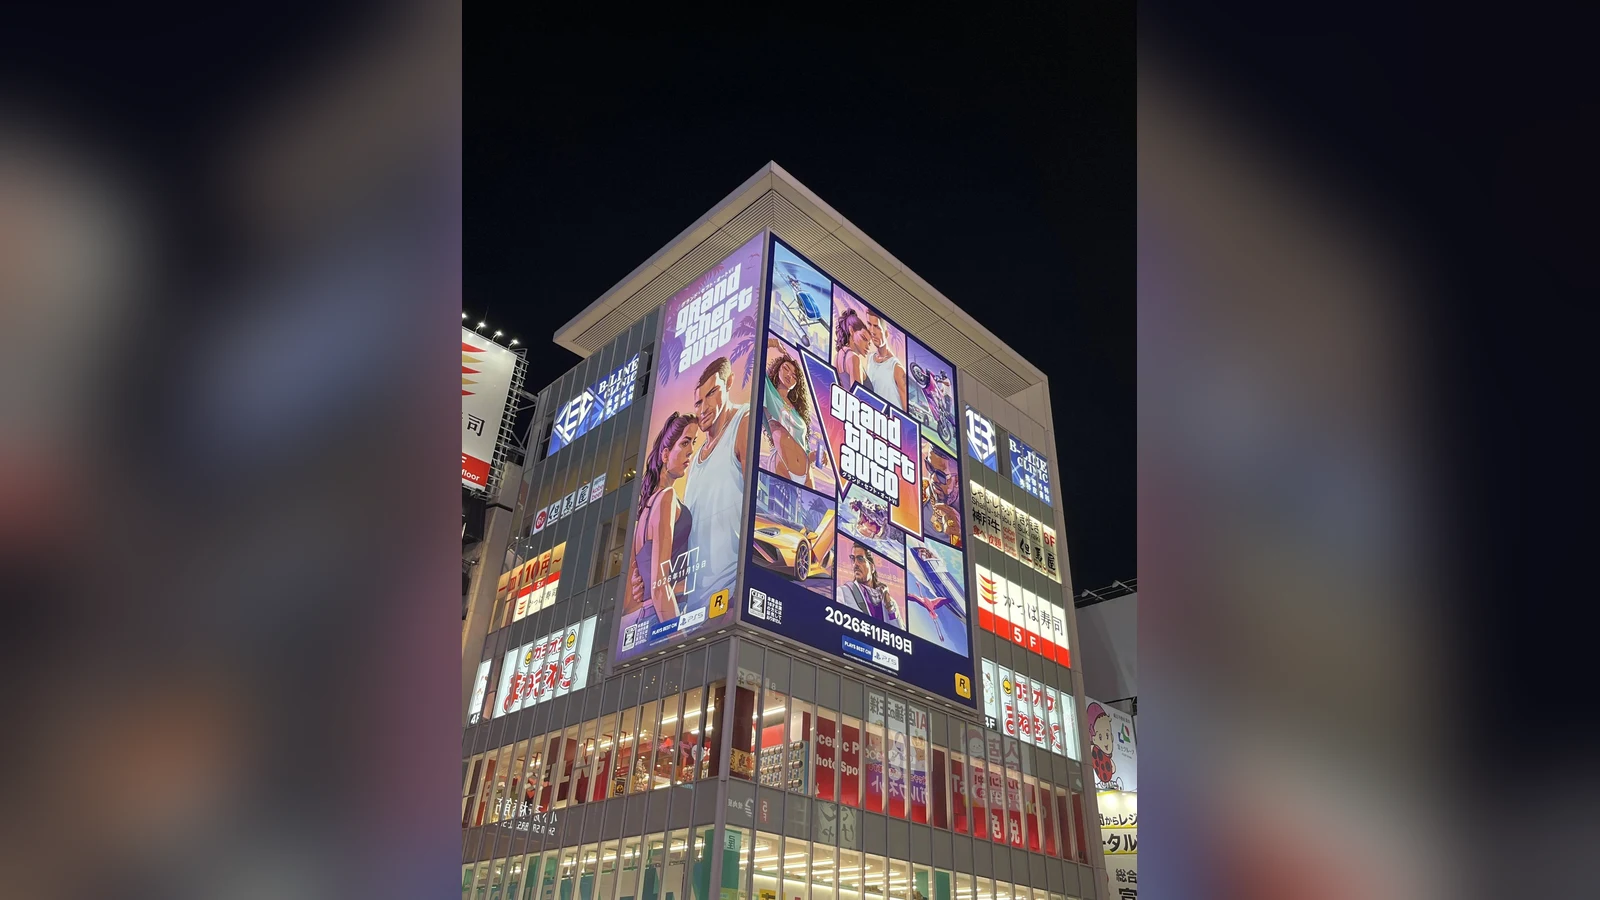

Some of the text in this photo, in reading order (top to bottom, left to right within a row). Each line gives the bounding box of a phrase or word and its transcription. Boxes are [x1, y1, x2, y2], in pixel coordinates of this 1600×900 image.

[972, 507, 1001, 534] 神戸牛
[1043, 532, 1056, 547] 6F
[652, 559, 707, 589] 2026年11月19日
[688, 611, 704, 622] PS5
[825, 606, 912, 655] 2026年11月19日
[1116, 868, 1137, 884] 総合
